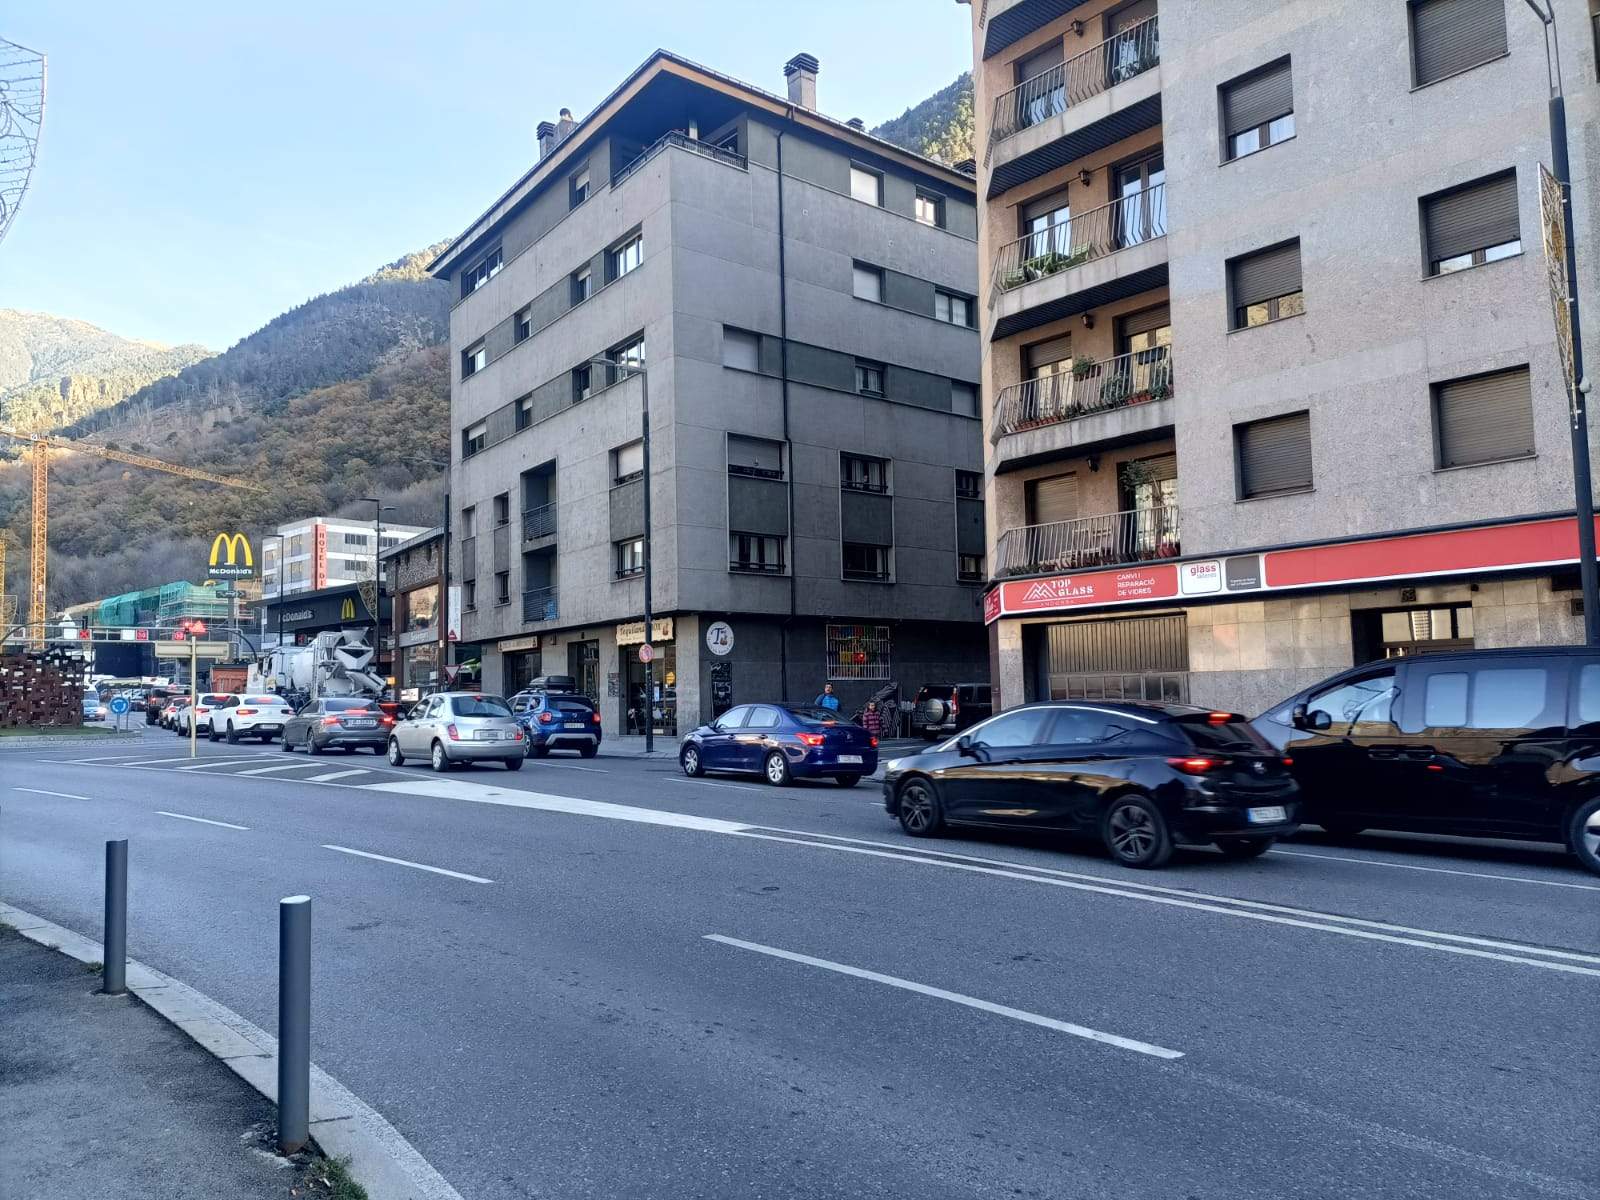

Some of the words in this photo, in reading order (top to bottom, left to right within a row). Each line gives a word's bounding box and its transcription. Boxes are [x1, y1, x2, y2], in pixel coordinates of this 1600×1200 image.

[1190, 564, 1217, 576] glass
[1117, 573, 1137, 581] CANVI
[1051, 579, 1071, 589] TOP
[1117, 578, 1156, 588] REPARACIÓ
[1058, 585, 1094, 597] GLASS
[278, 610, 313, 622] cDonald's
